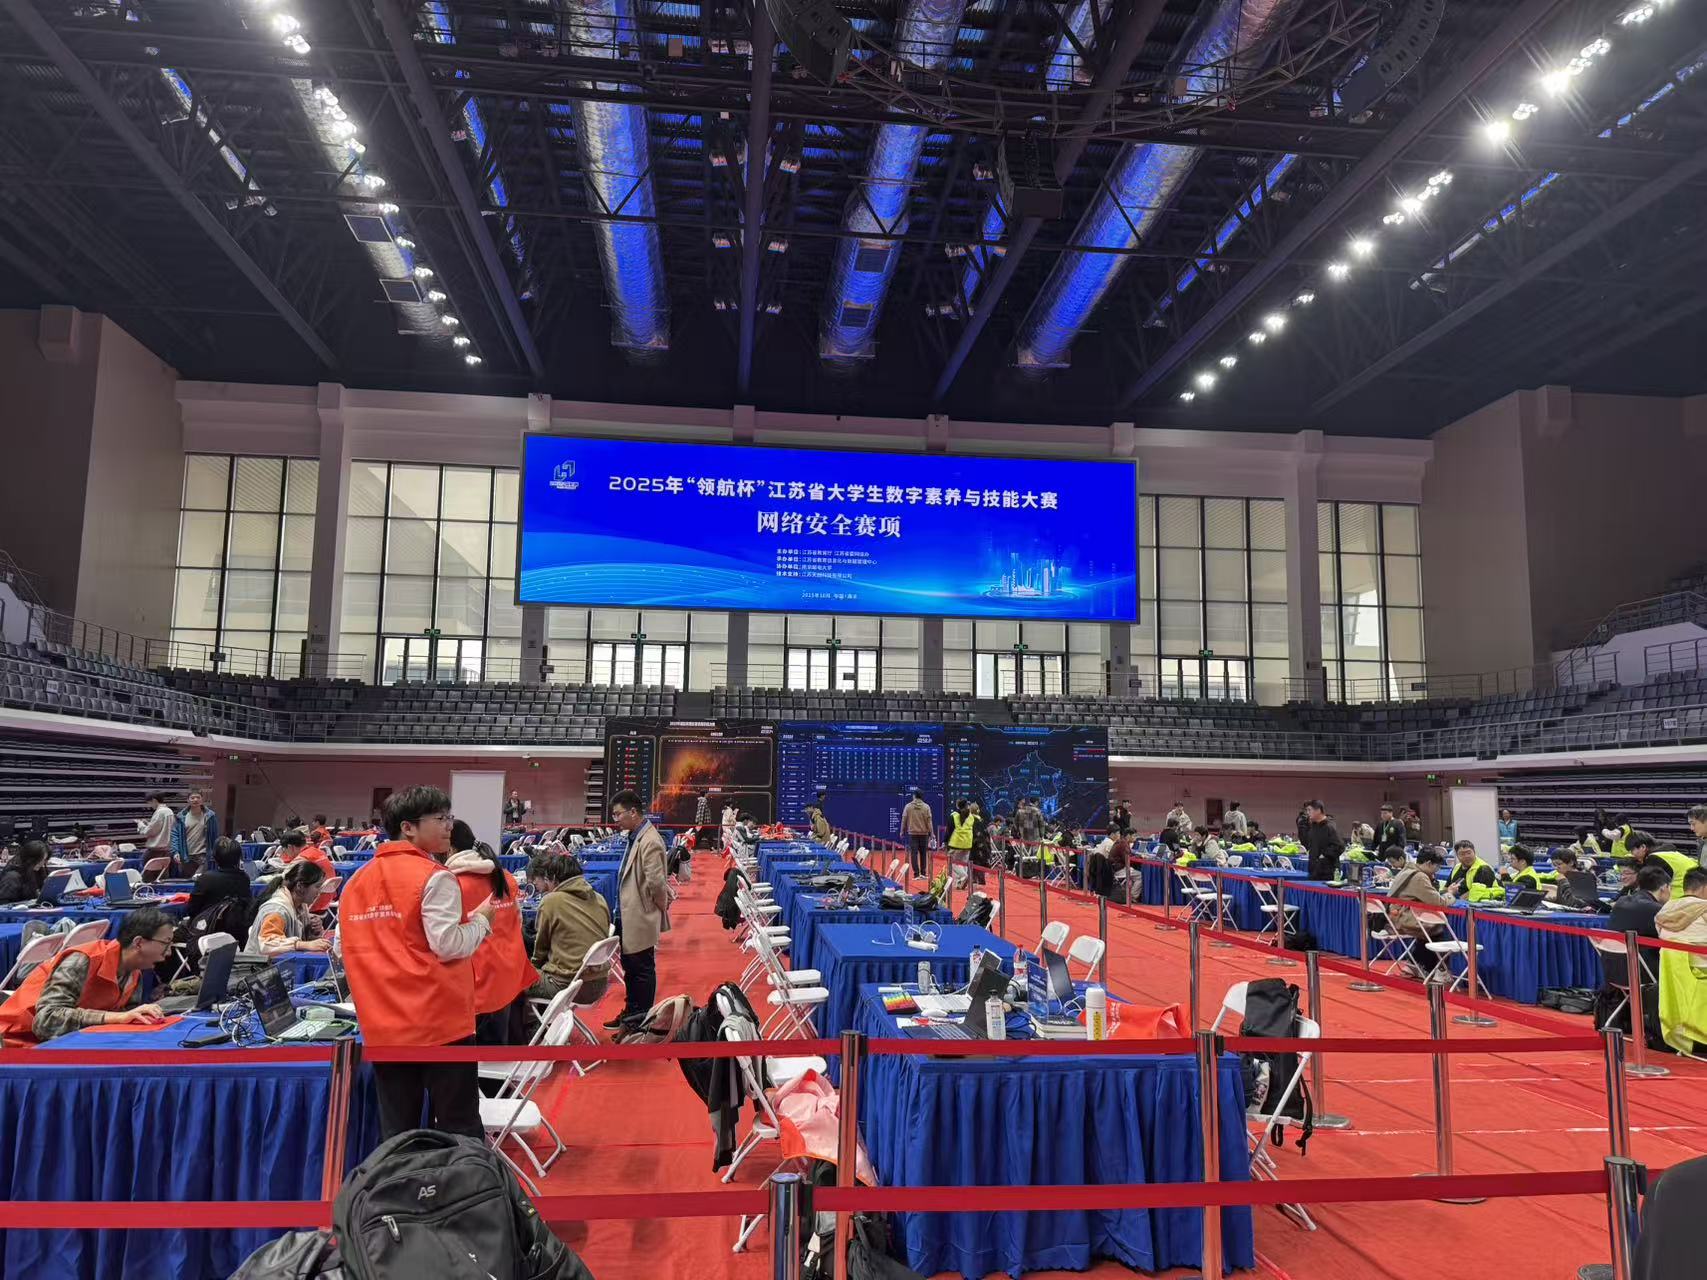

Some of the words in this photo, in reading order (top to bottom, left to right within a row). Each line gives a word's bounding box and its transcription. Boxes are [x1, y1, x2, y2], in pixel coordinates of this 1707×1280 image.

[609, 475, 1058, 510] 2025年“领航杯”江苏省大学生数字素养与技能大赛
[757, 510, 901, 538] 网络安全赛项
[417, 1184, 437, 1200] AS
